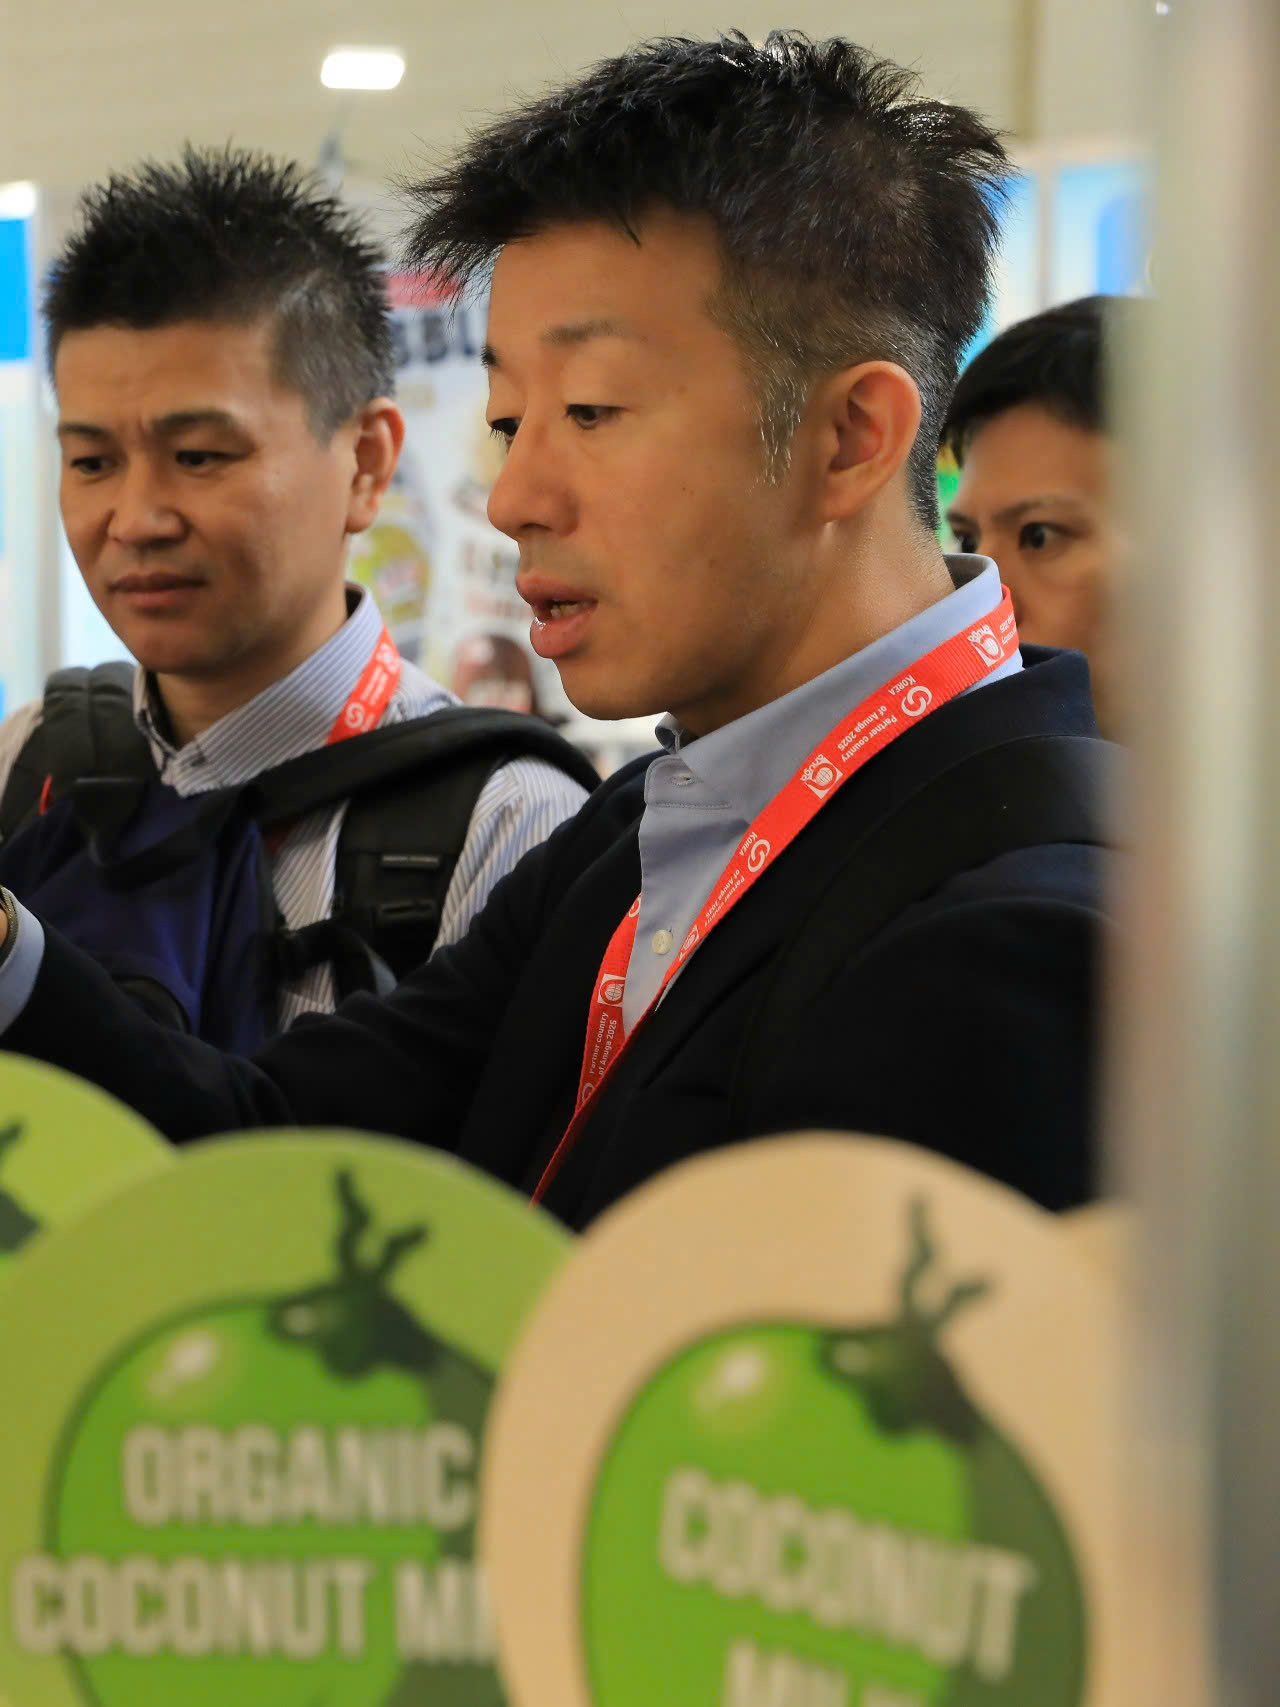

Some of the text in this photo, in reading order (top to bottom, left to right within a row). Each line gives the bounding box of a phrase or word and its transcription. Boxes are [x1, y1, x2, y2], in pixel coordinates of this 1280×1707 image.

[888, 674, 916, 696] KOREA
[837, 705, 887, 751] of Anuga 2025
[841, 714, 898, 762] Partner country
[800, 753, 824, 781] anuga
[739, 831, 758, 856] KOREA
[718, 877, 734, 901] Anuga
[724, 875, 745, 902] Partner
[733, 869, 740, 878] of
[597, 1012, 609, 1043] country
[600, 1041, 612, 1067] Anuga
[606, 1020, 617, 1040] 2025
[122, 1422, 474, 1532] ORGANIC
[660, 1465, 1036, 1683] COCONUT
[15, 1555, 372, 1661] COCONUT
